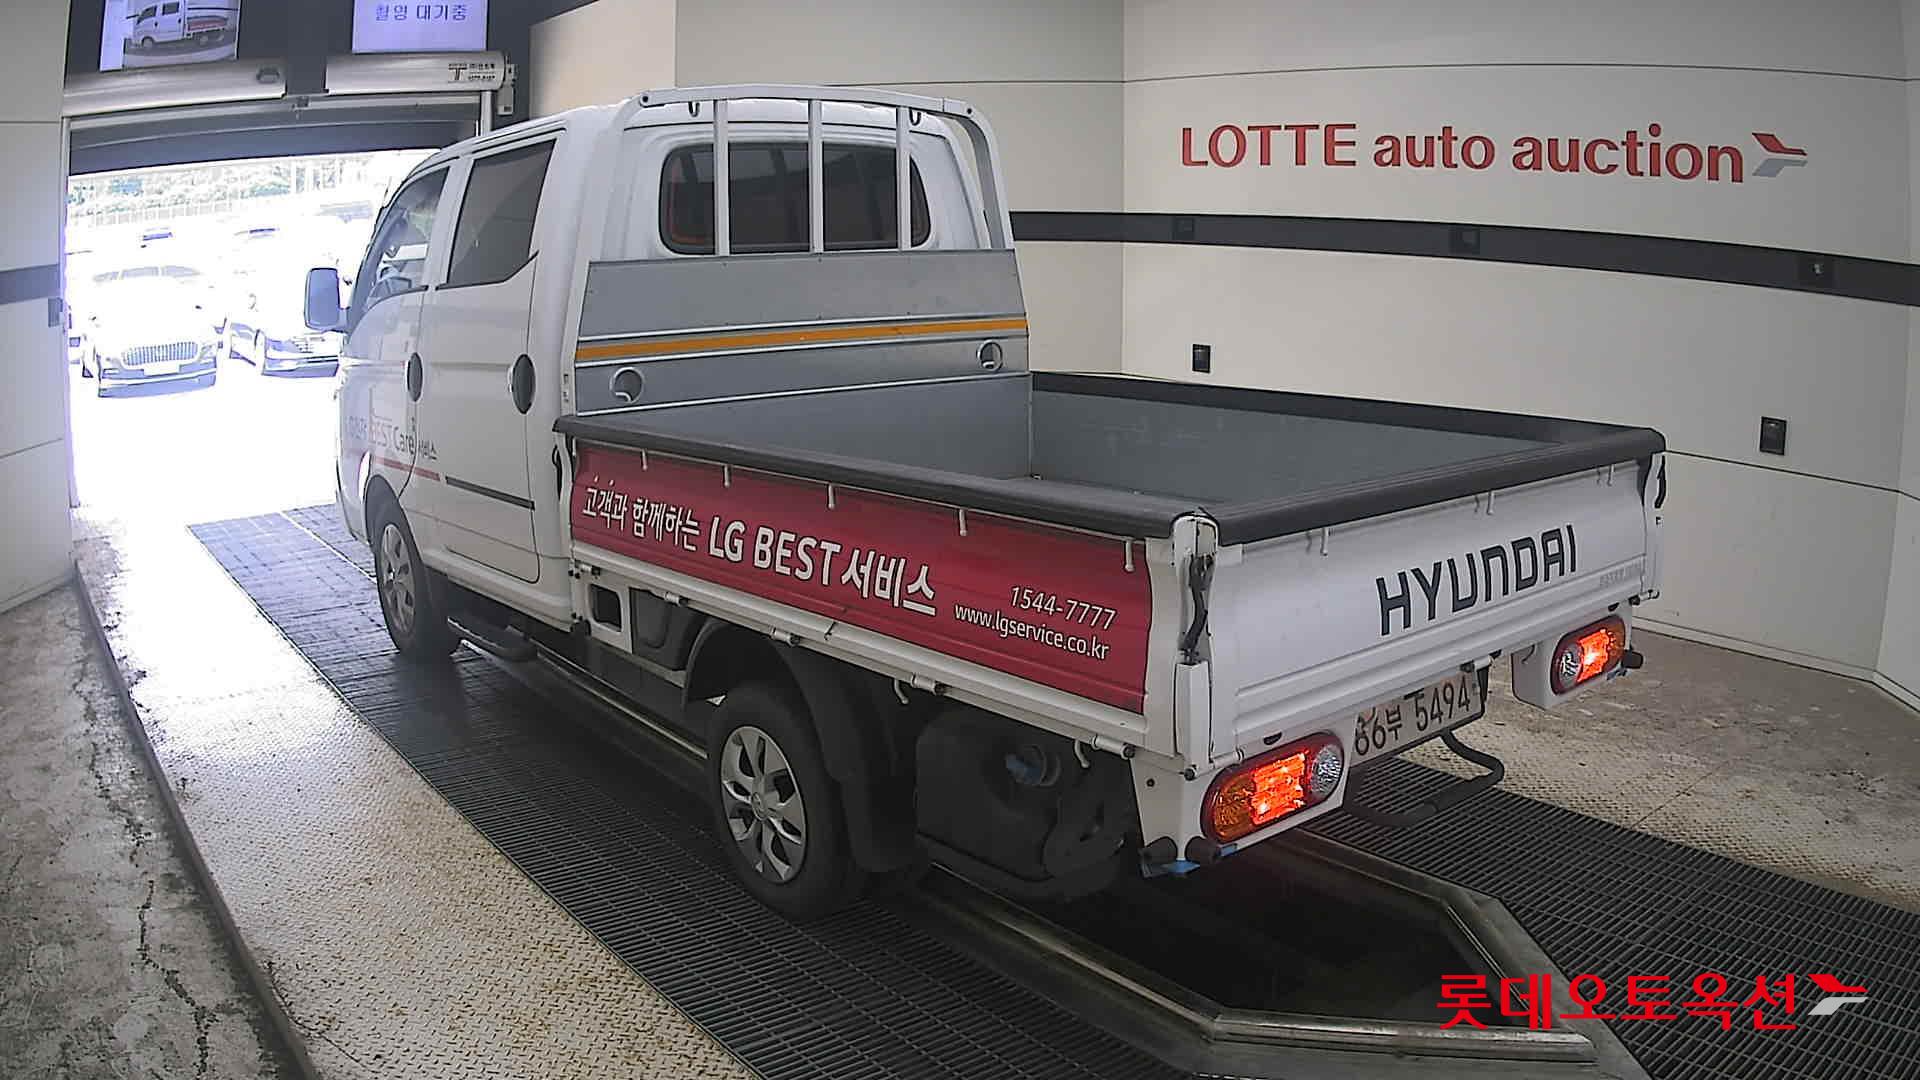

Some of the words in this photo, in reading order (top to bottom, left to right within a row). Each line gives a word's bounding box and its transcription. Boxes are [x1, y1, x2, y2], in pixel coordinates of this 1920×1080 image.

[416, 4, 466, 22] 대기중
[1181, 123, 1357, 168] LOTTE
[1373, 125, 1496, 170] auto
[1511, 123, 1744, 184] auction
[582, 486, 628, 531] 고객과
[632, 497, 701, 551] 함께하는
[708, 515, 746, 563] LG
[753, 526, 841, 586] BEST
[841, 549, 936, 617] 서비스
[1375, 523, 1577, 637] HYUNDAI
[954, 603, 1110, 660] www.lgservice.co.kr
[1011, 586, 1116, 630] 1544-7777
[1414, 675, 1472, 732] 5494
